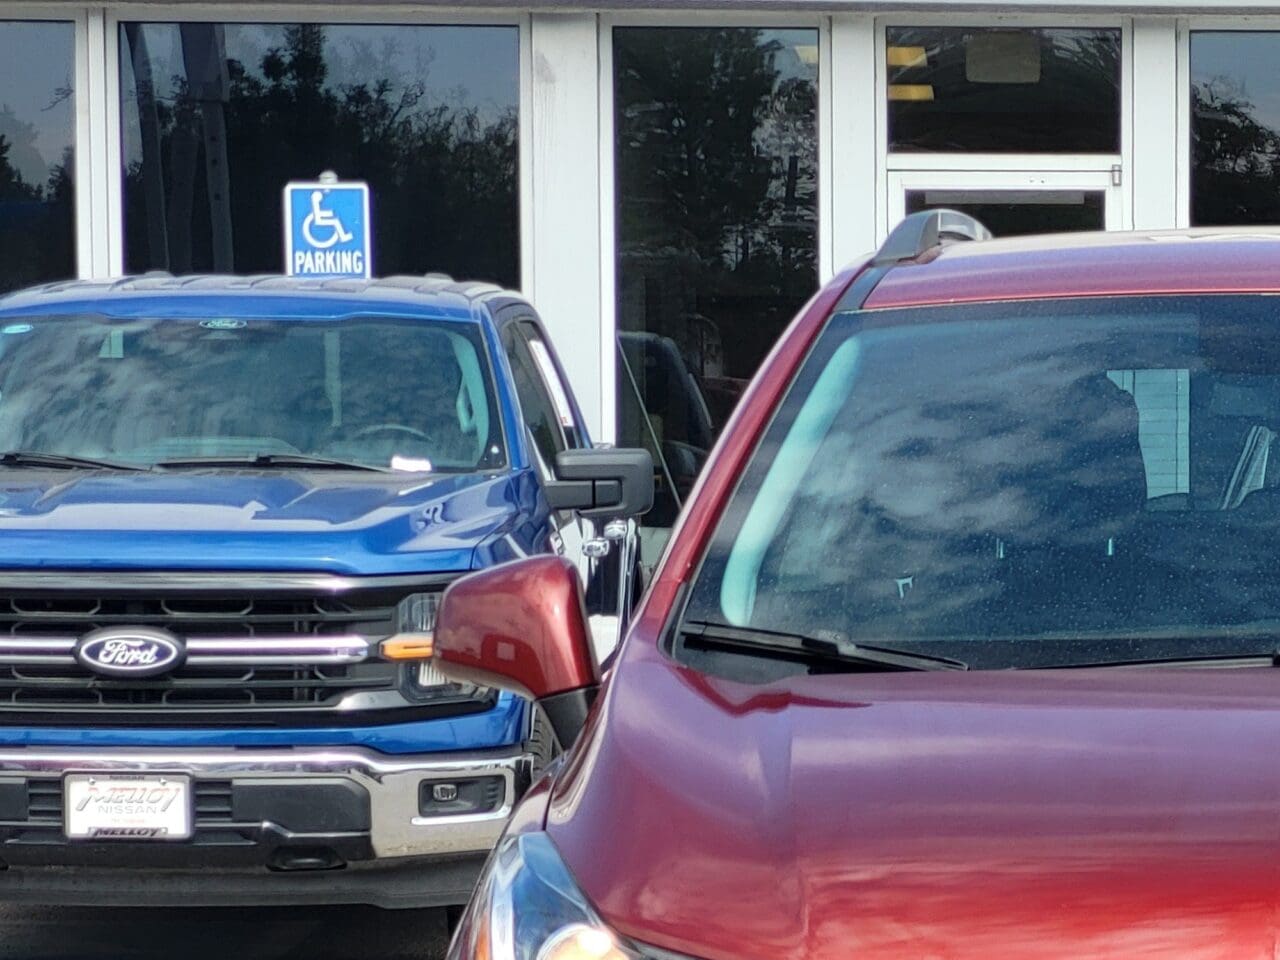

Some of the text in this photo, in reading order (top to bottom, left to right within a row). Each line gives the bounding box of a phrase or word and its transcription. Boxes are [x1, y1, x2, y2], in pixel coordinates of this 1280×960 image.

[295, 250, 363, 274] PARKING
[99, 639, 159, 665] Ford
[97, 805, 158, 815] NISSAN
